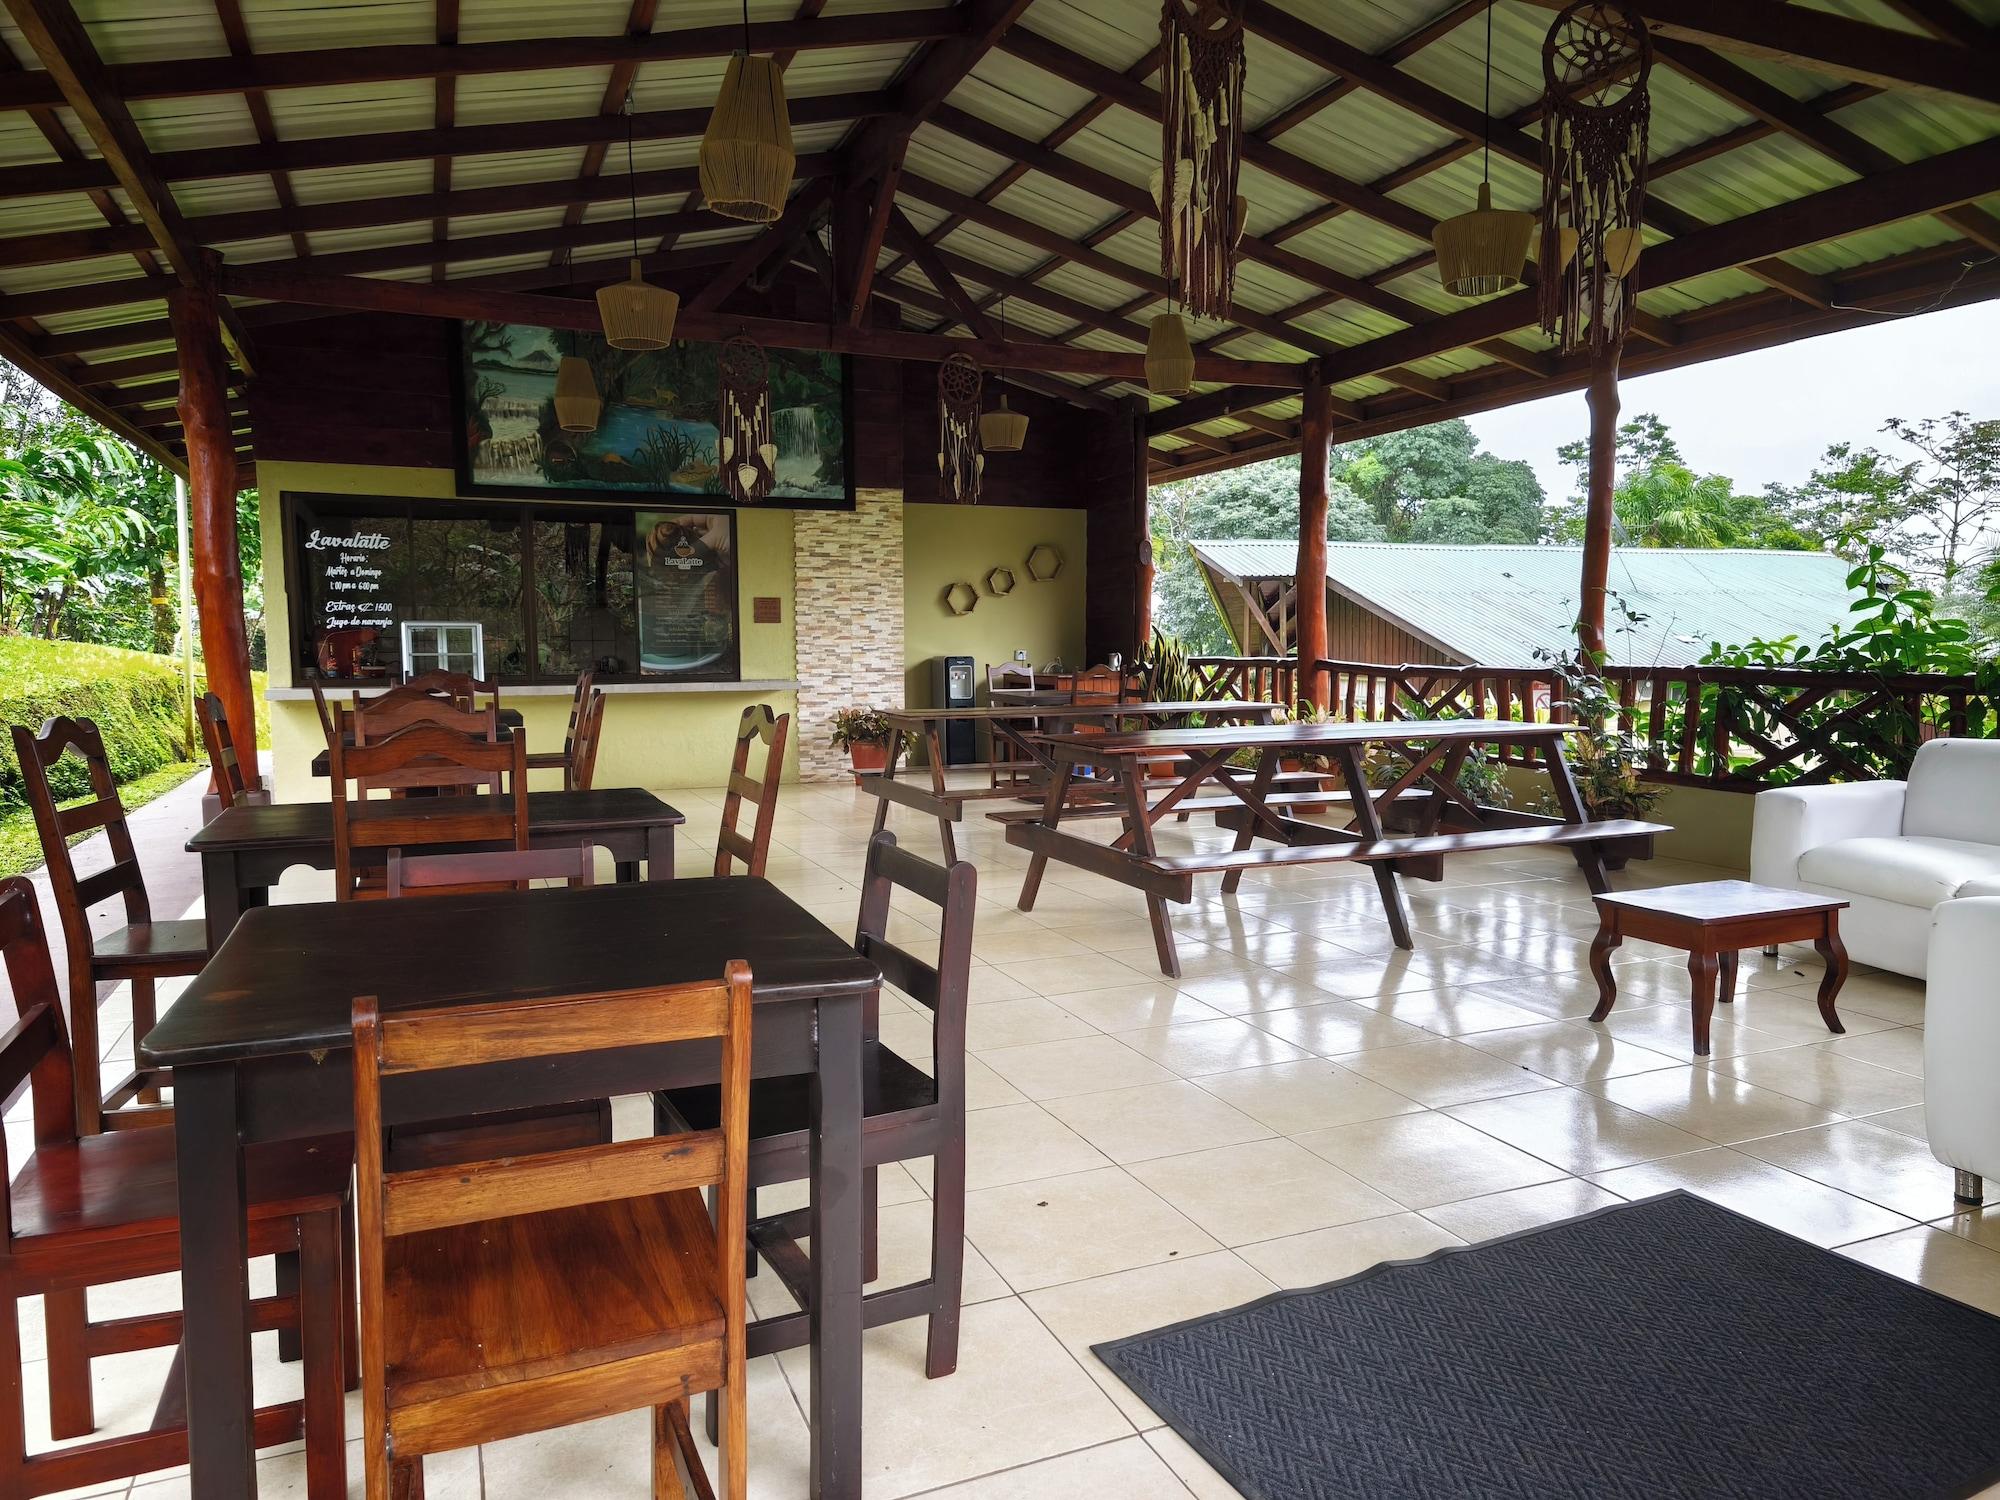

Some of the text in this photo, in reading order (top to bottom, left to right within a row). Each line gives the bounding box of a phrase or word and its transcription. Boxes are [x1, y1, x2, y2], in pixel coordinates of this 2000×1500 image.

[305, 530, 391, 550] Lavalatte
[340, 552, 368, 564] Horario:
[325, 565, 348, 577] Martes
[356, 566, 382, 579] Domingo
[325, 600, 356, 613] Extras
[375, 602, 393, 612] 1500
[326, 615, 393, 629] Jugo de naranja
